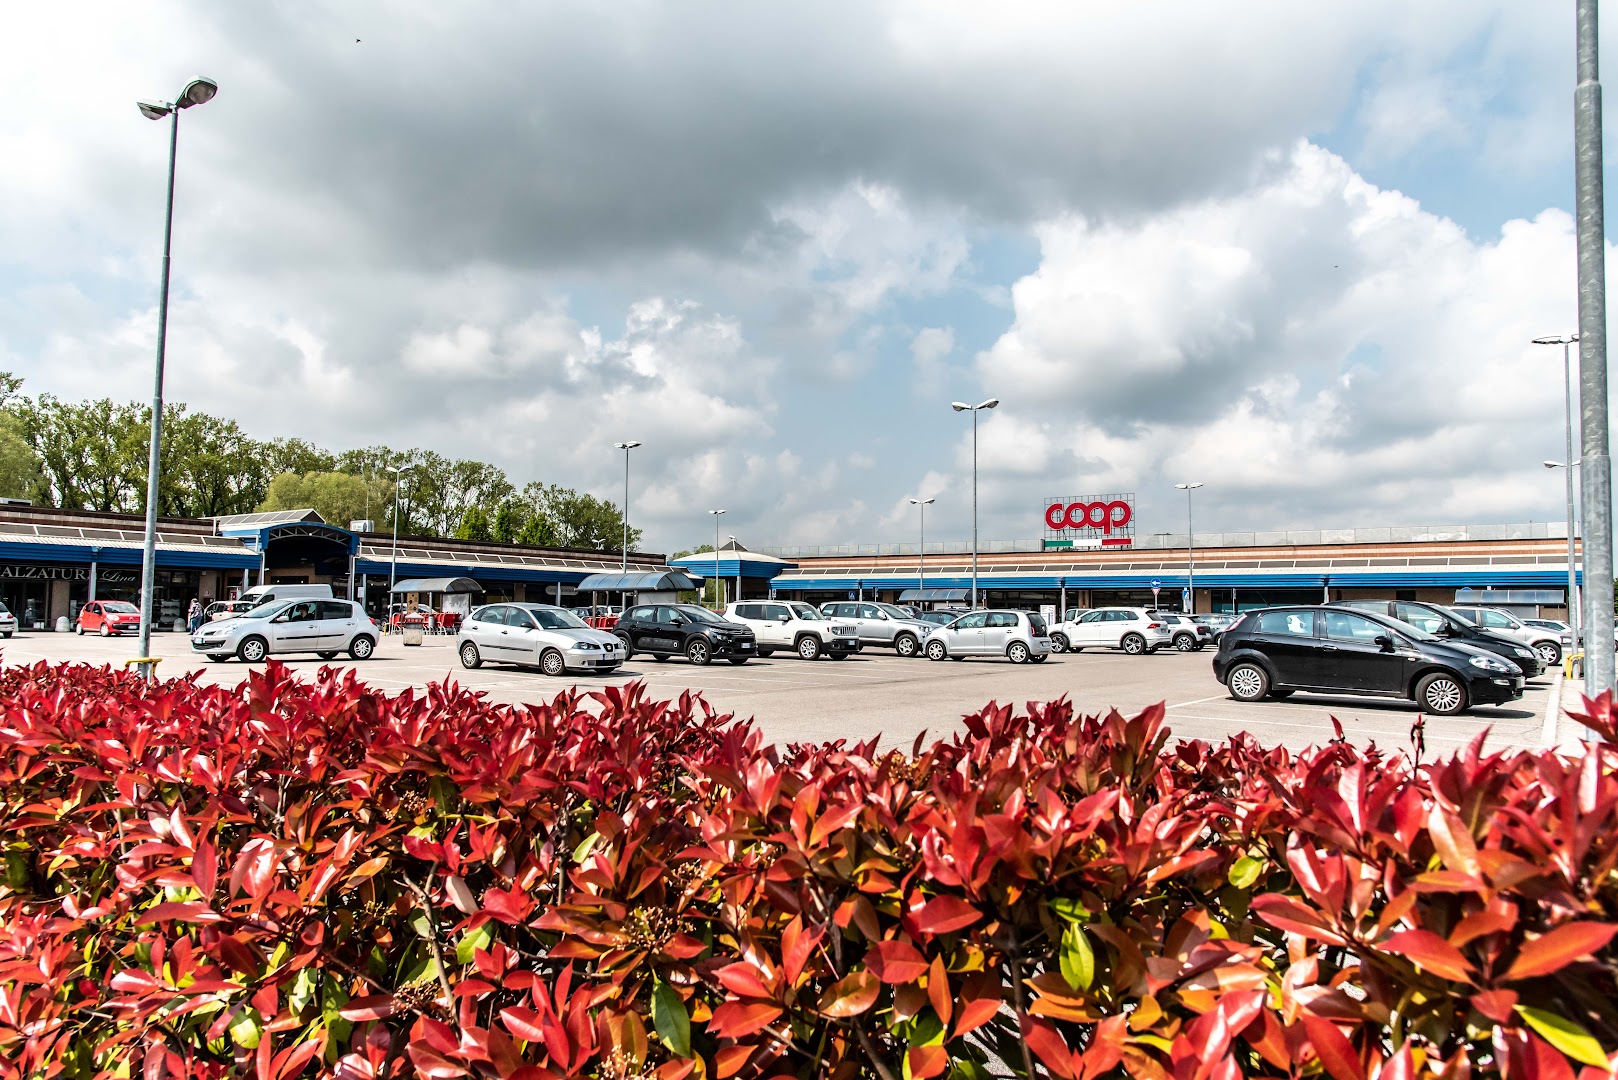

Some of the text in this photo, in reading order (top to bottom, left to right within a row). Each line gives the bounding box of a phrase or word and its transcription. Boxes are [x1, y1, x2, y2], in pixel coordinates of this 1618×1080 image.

[1045, 500, 1132, 535] coop
[0, 565, 136, 582] ALZATUR Lina
